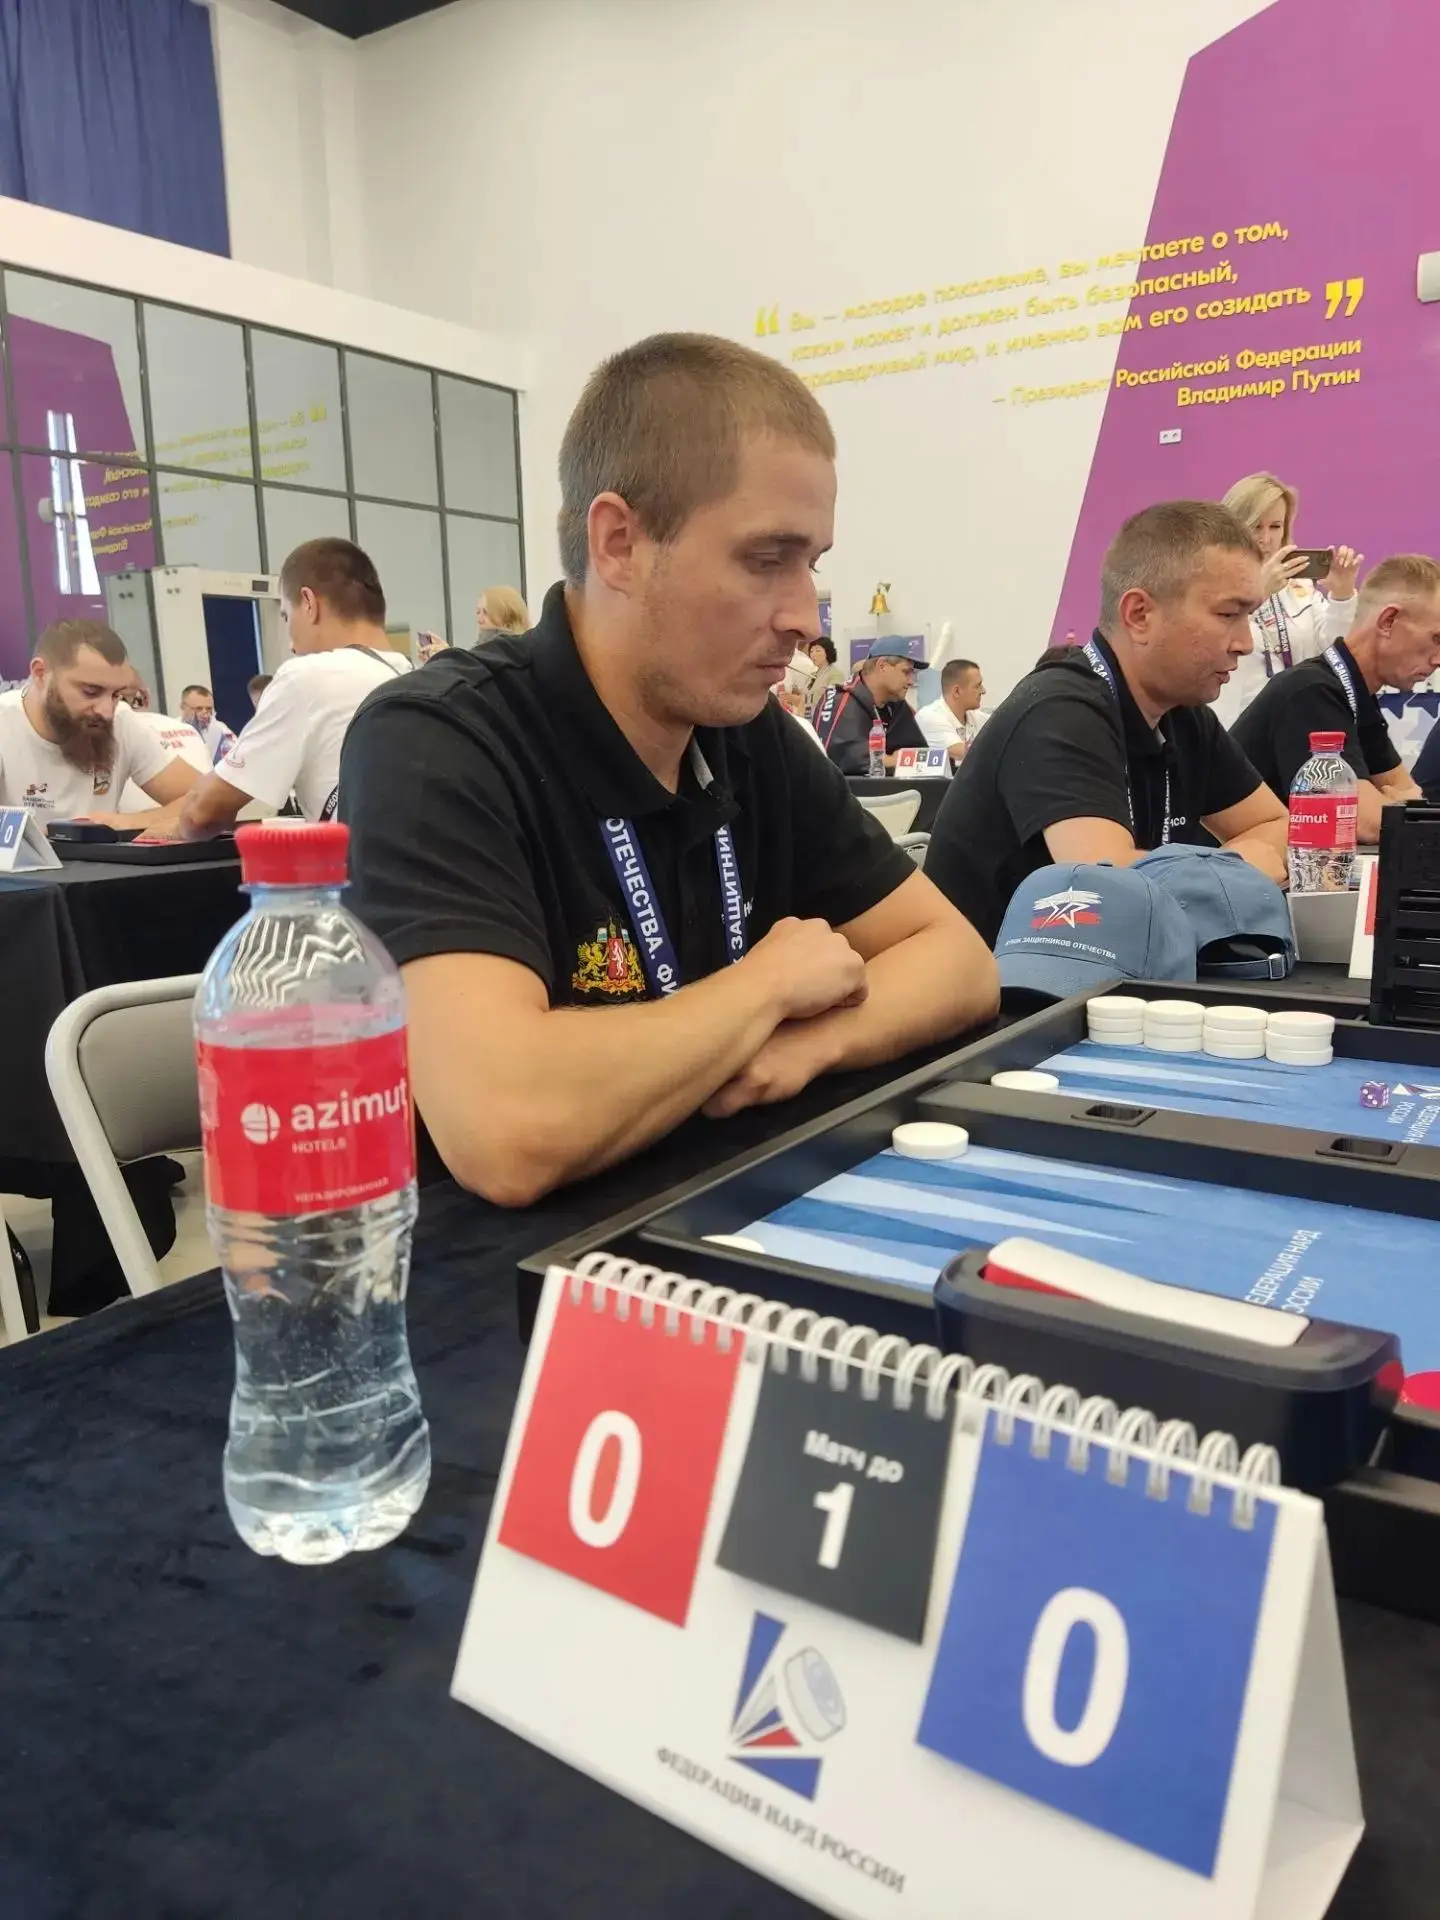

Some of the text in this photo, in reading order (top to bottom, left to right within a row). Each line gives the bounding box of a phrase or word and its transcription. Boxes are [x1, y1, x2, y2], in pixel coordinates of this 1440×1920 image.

[1096, 234, 1205, 271] мечтаете
[1211, 230, 1228, 249] о
[1234, 220, 1289, 246] том,
[938, 307, 1019, 339] должен
[1026, 295, 1079, 317] быть
[1086, 260, 1239, 306] безопасный,
[1096, 314, 1143, 338] вам
[1149, 305, 1189, 329] его
[1195, 284, 1312, 321] созидать
[1115, 354, 1230, 389] Российской
[1235, 338, 1362, 372] Федерации
[1176, 366, 1362, 407] Владимир Путин
[932, 755, 939, 766] 0
[1289, 811, 1329, 824] azimut
[605, 817, 664, 961] ОТЕЧЕСТВА.
[1072, 941, 1117, 960] ОТЕЧЕСТВА
[290, 1076, 408, 1133] azimut
[291, 1137, 347, 1154] HOTELS
[1243, 1251, 1303, 1306] ЕДЕРАЦИЯ
[1281, 1275, 1325, 1314] ОССИИ
[567, 1409, 643, 1549] 0
[803, 1429, 904, 1484] Матч до
[812, 1481, 856, 1571] 1
[1022, 1585, 1131, 1768] 0
[657, 1747, 906, 1894] ФЕДЕРАЦИЯ НАРД РОССИИ
